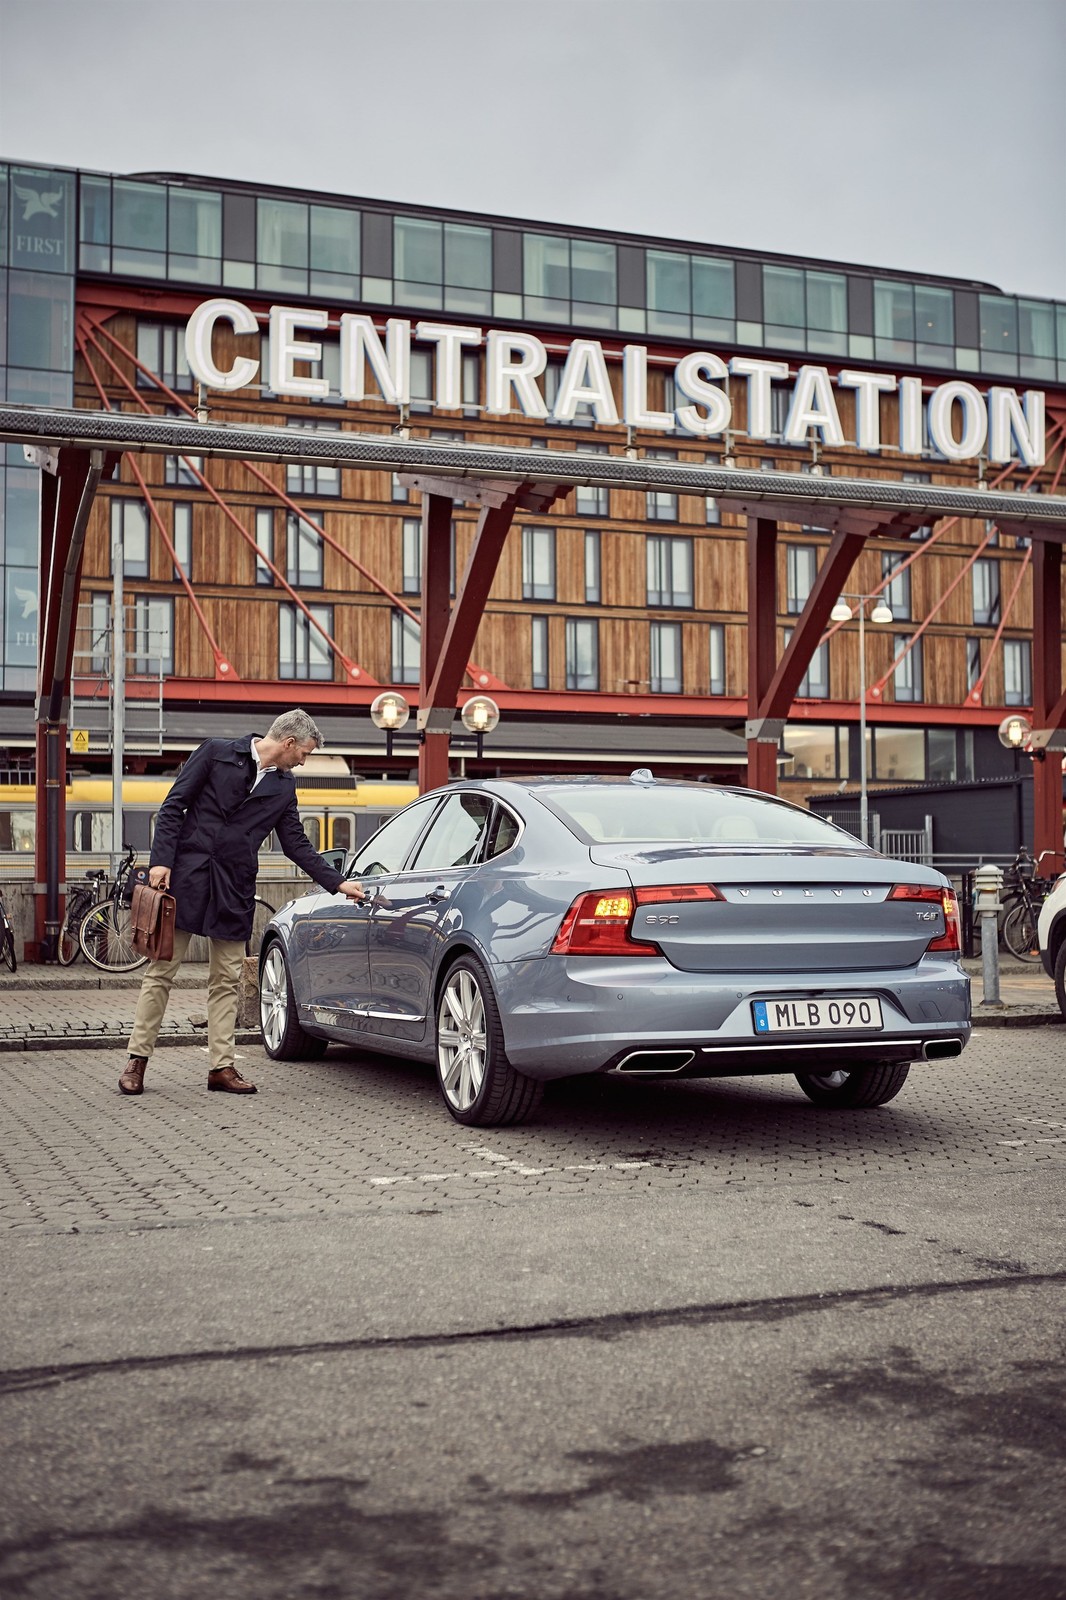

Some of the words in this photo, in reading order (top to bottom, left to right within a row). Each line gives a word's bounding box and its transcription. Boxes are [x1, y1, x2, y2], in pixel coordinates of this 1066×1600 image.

[16, 235, 64, 256] FIRST
[185, 298, 1047, 467] CENTRALSTATION
[738, 888, 873, 897] VOLVO
[645, 915, 680, 925] S90
[775, 1003, 820, 1027] MLB
[828, 1002, 871, 1025] 090
